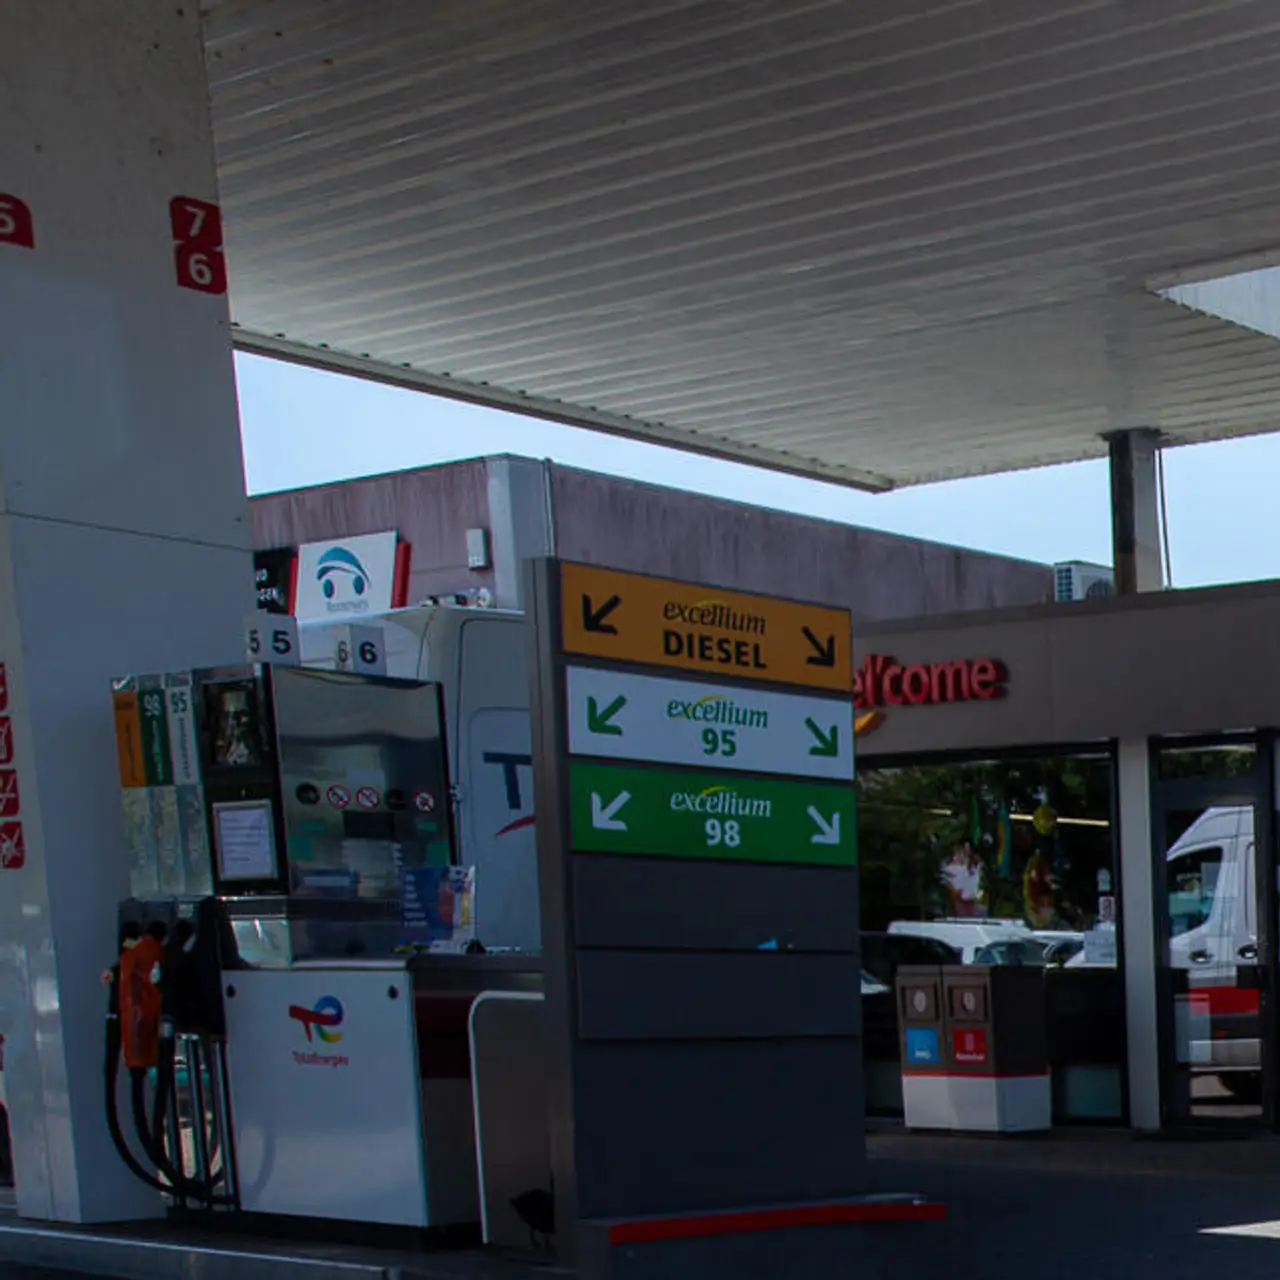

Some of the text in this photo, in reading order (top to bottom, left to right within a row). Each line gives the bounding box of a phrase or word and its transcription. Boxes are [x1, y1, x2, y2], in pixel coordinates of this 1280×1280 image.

[183, 204, 207, 238] 7
[187, 252, 213, 286] 6
[663, 601, 767, 636] excellium
[272, 630, 291, 654] 5
[359, 641, 377, 664] 6
[663, 629, 769, 669] DIESEL
[667, 698, 769, 729] excellium
[701, 727, 737, 757] 95
[669, 790, 772, 818] excellium
[704, 818, 741, 848] 98
